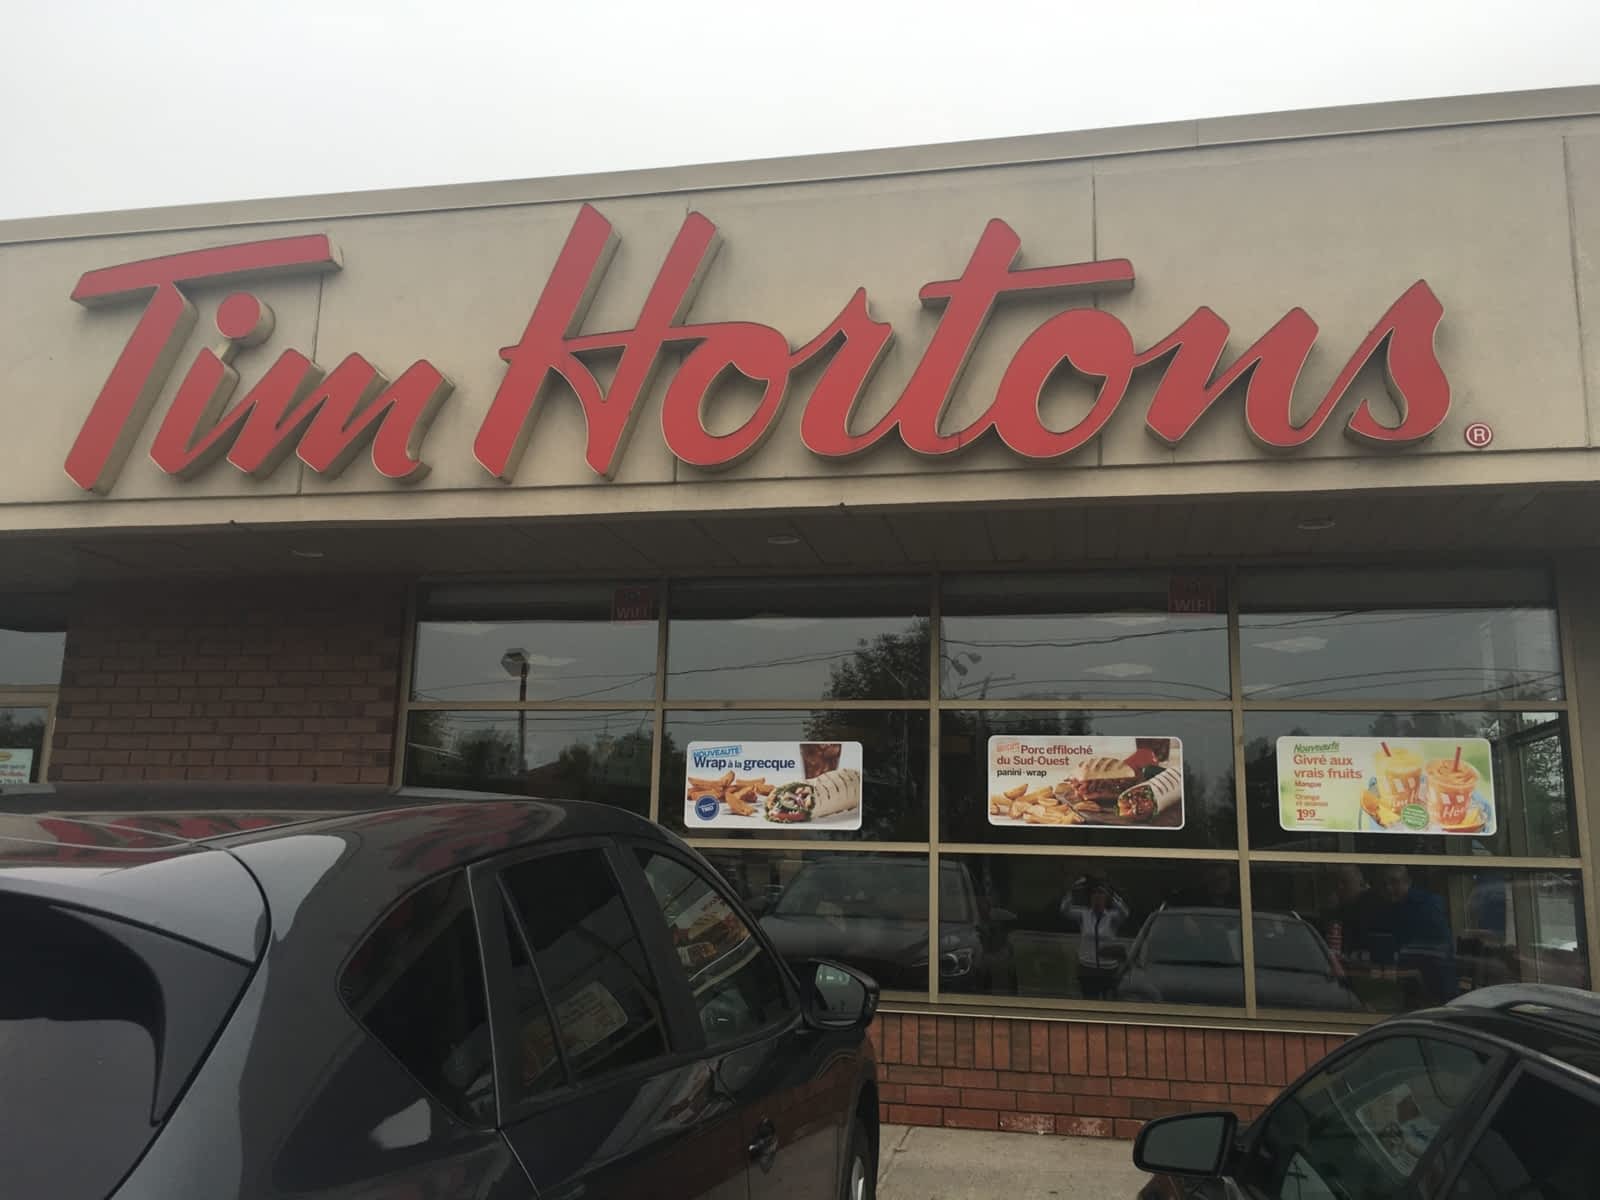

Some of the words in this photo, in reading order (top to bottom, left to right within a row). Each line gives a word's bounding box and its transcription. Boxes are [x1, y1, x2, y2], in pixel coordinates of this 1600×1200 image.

[64, 233, 455, 494] Tim
[473, 203, 1452, 483] Hortons
[1021, 745, 1045, 755] Porc
[1047, 744, 1093, 755] effiloché
[694, 756, 727, 771] Wrap
[734, 760, 742, 768] la
[743, 759, 795, 771] grecque
[997, 755, 1010, 765] du
[1013, 755, 1069, 765] Sud-Ouest
[1294, 754, 1327, 766] Givré
[1329, 757, 1353, 766] aux
[996, 768, 1022, 778] panini
[1026, 770, 1047, 778] wrap
[1294, 767, 1325, 778] vrais
[1326, 768, 1363, 779] fruits
